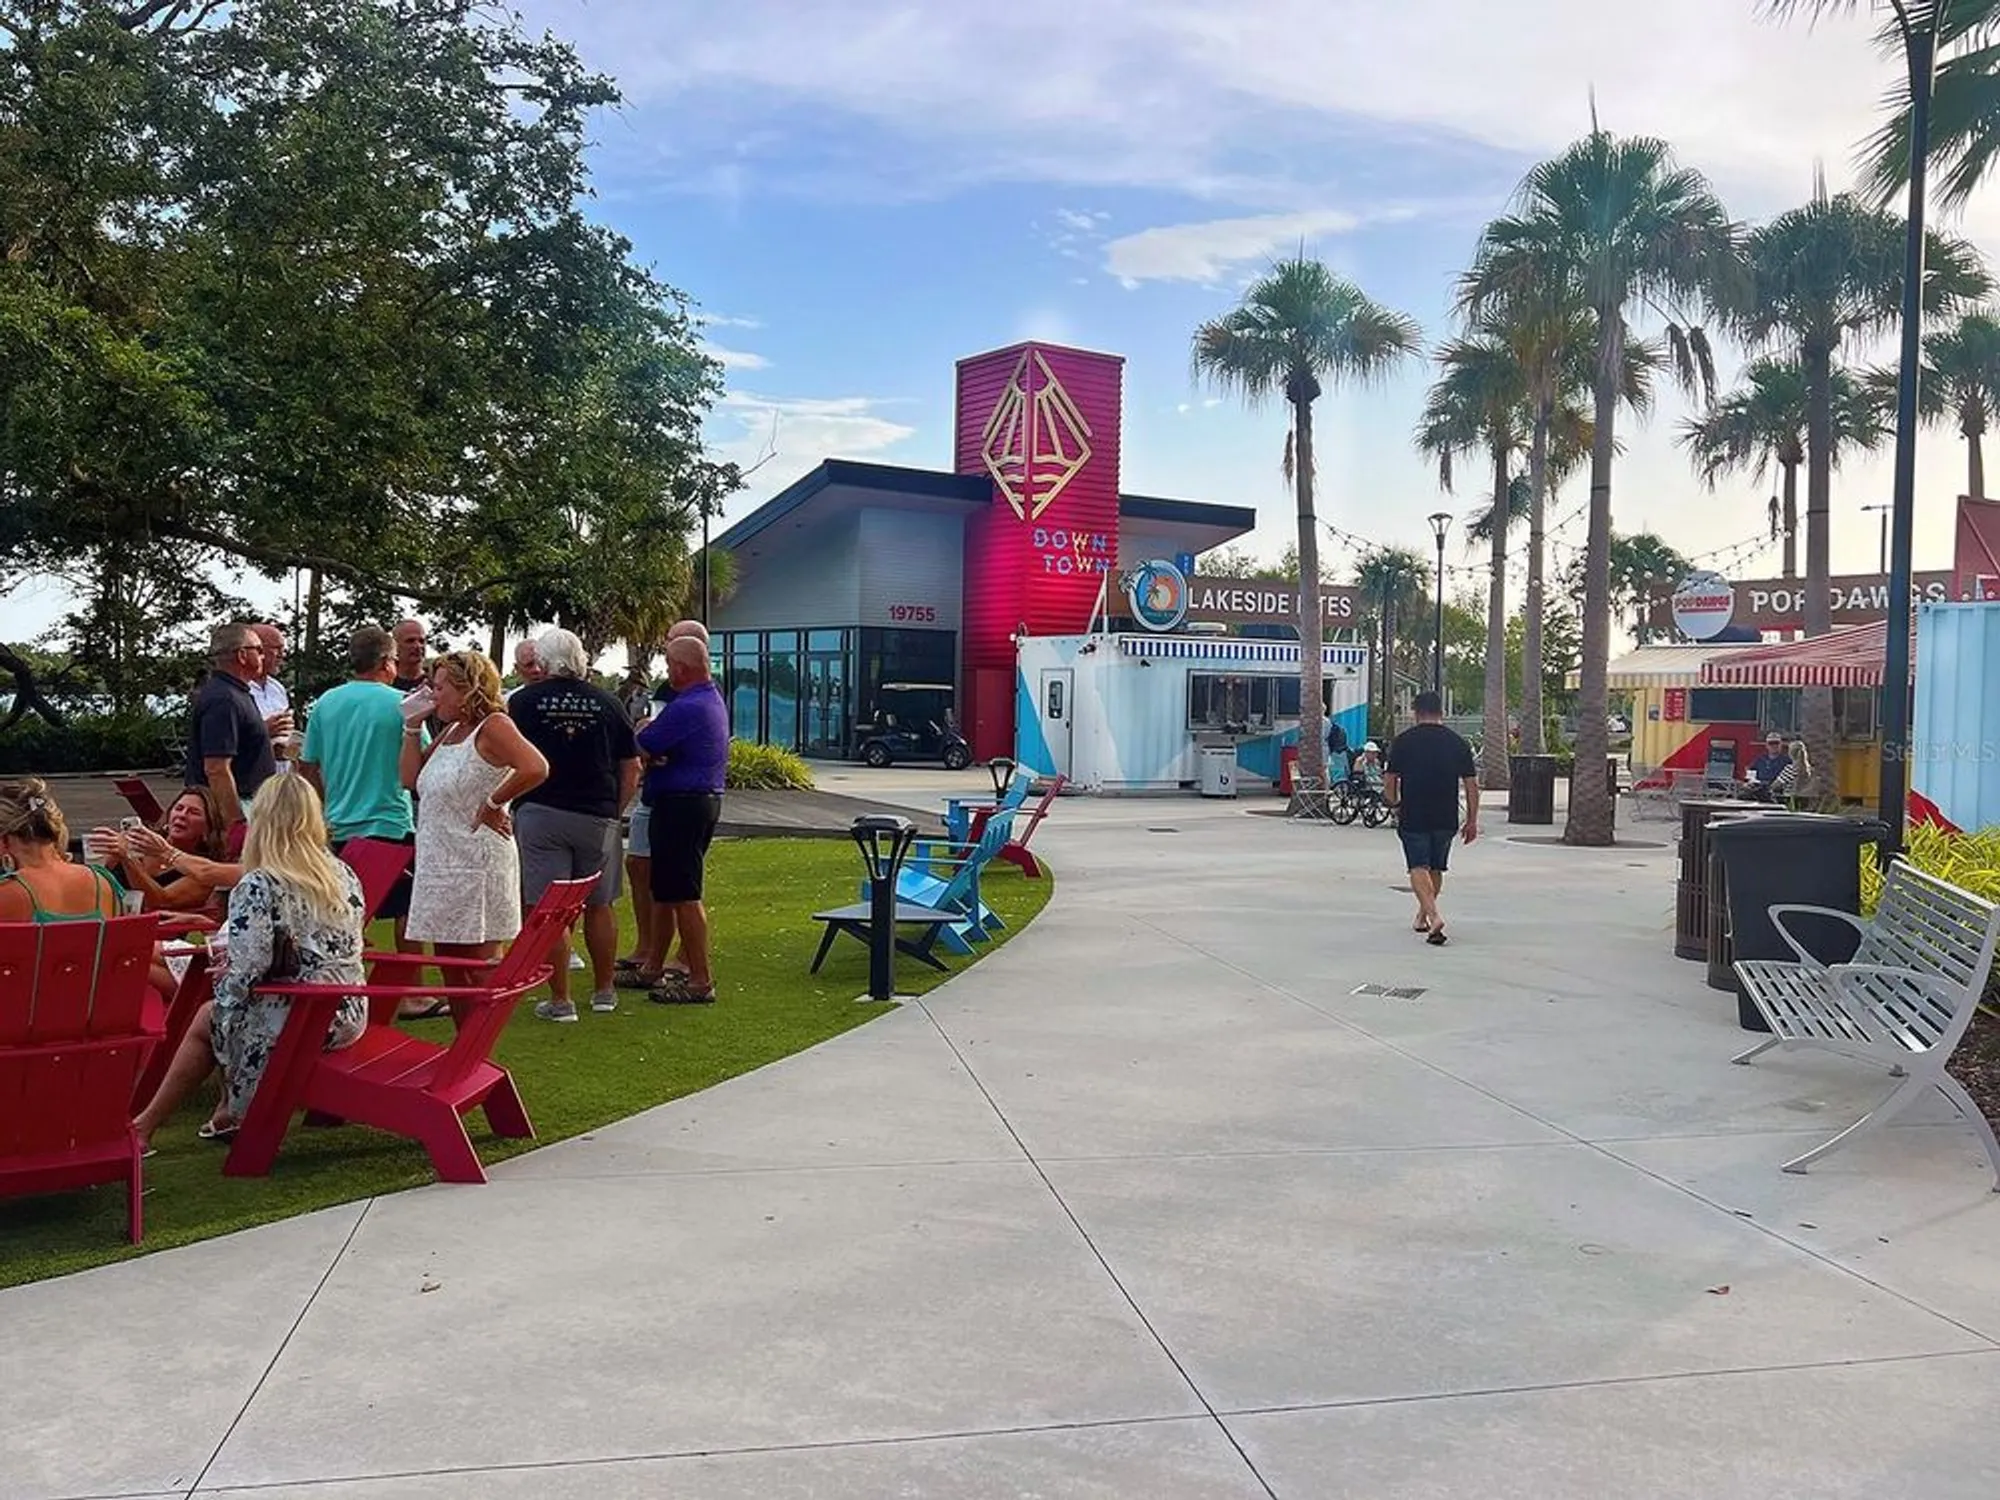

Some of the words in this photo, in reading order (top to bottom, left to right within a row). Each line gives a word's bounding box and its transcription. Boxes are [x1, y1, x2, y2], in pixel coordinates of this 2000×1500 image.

[1034, 528, 1107, 553] DOWN
[1043, 554, 1110, 575] TOWN
[888, 605, 935, 622] 19755
[1188, 587, 1289, 614] LAKESIDE
[1296, 594, 1351, 617] TES
